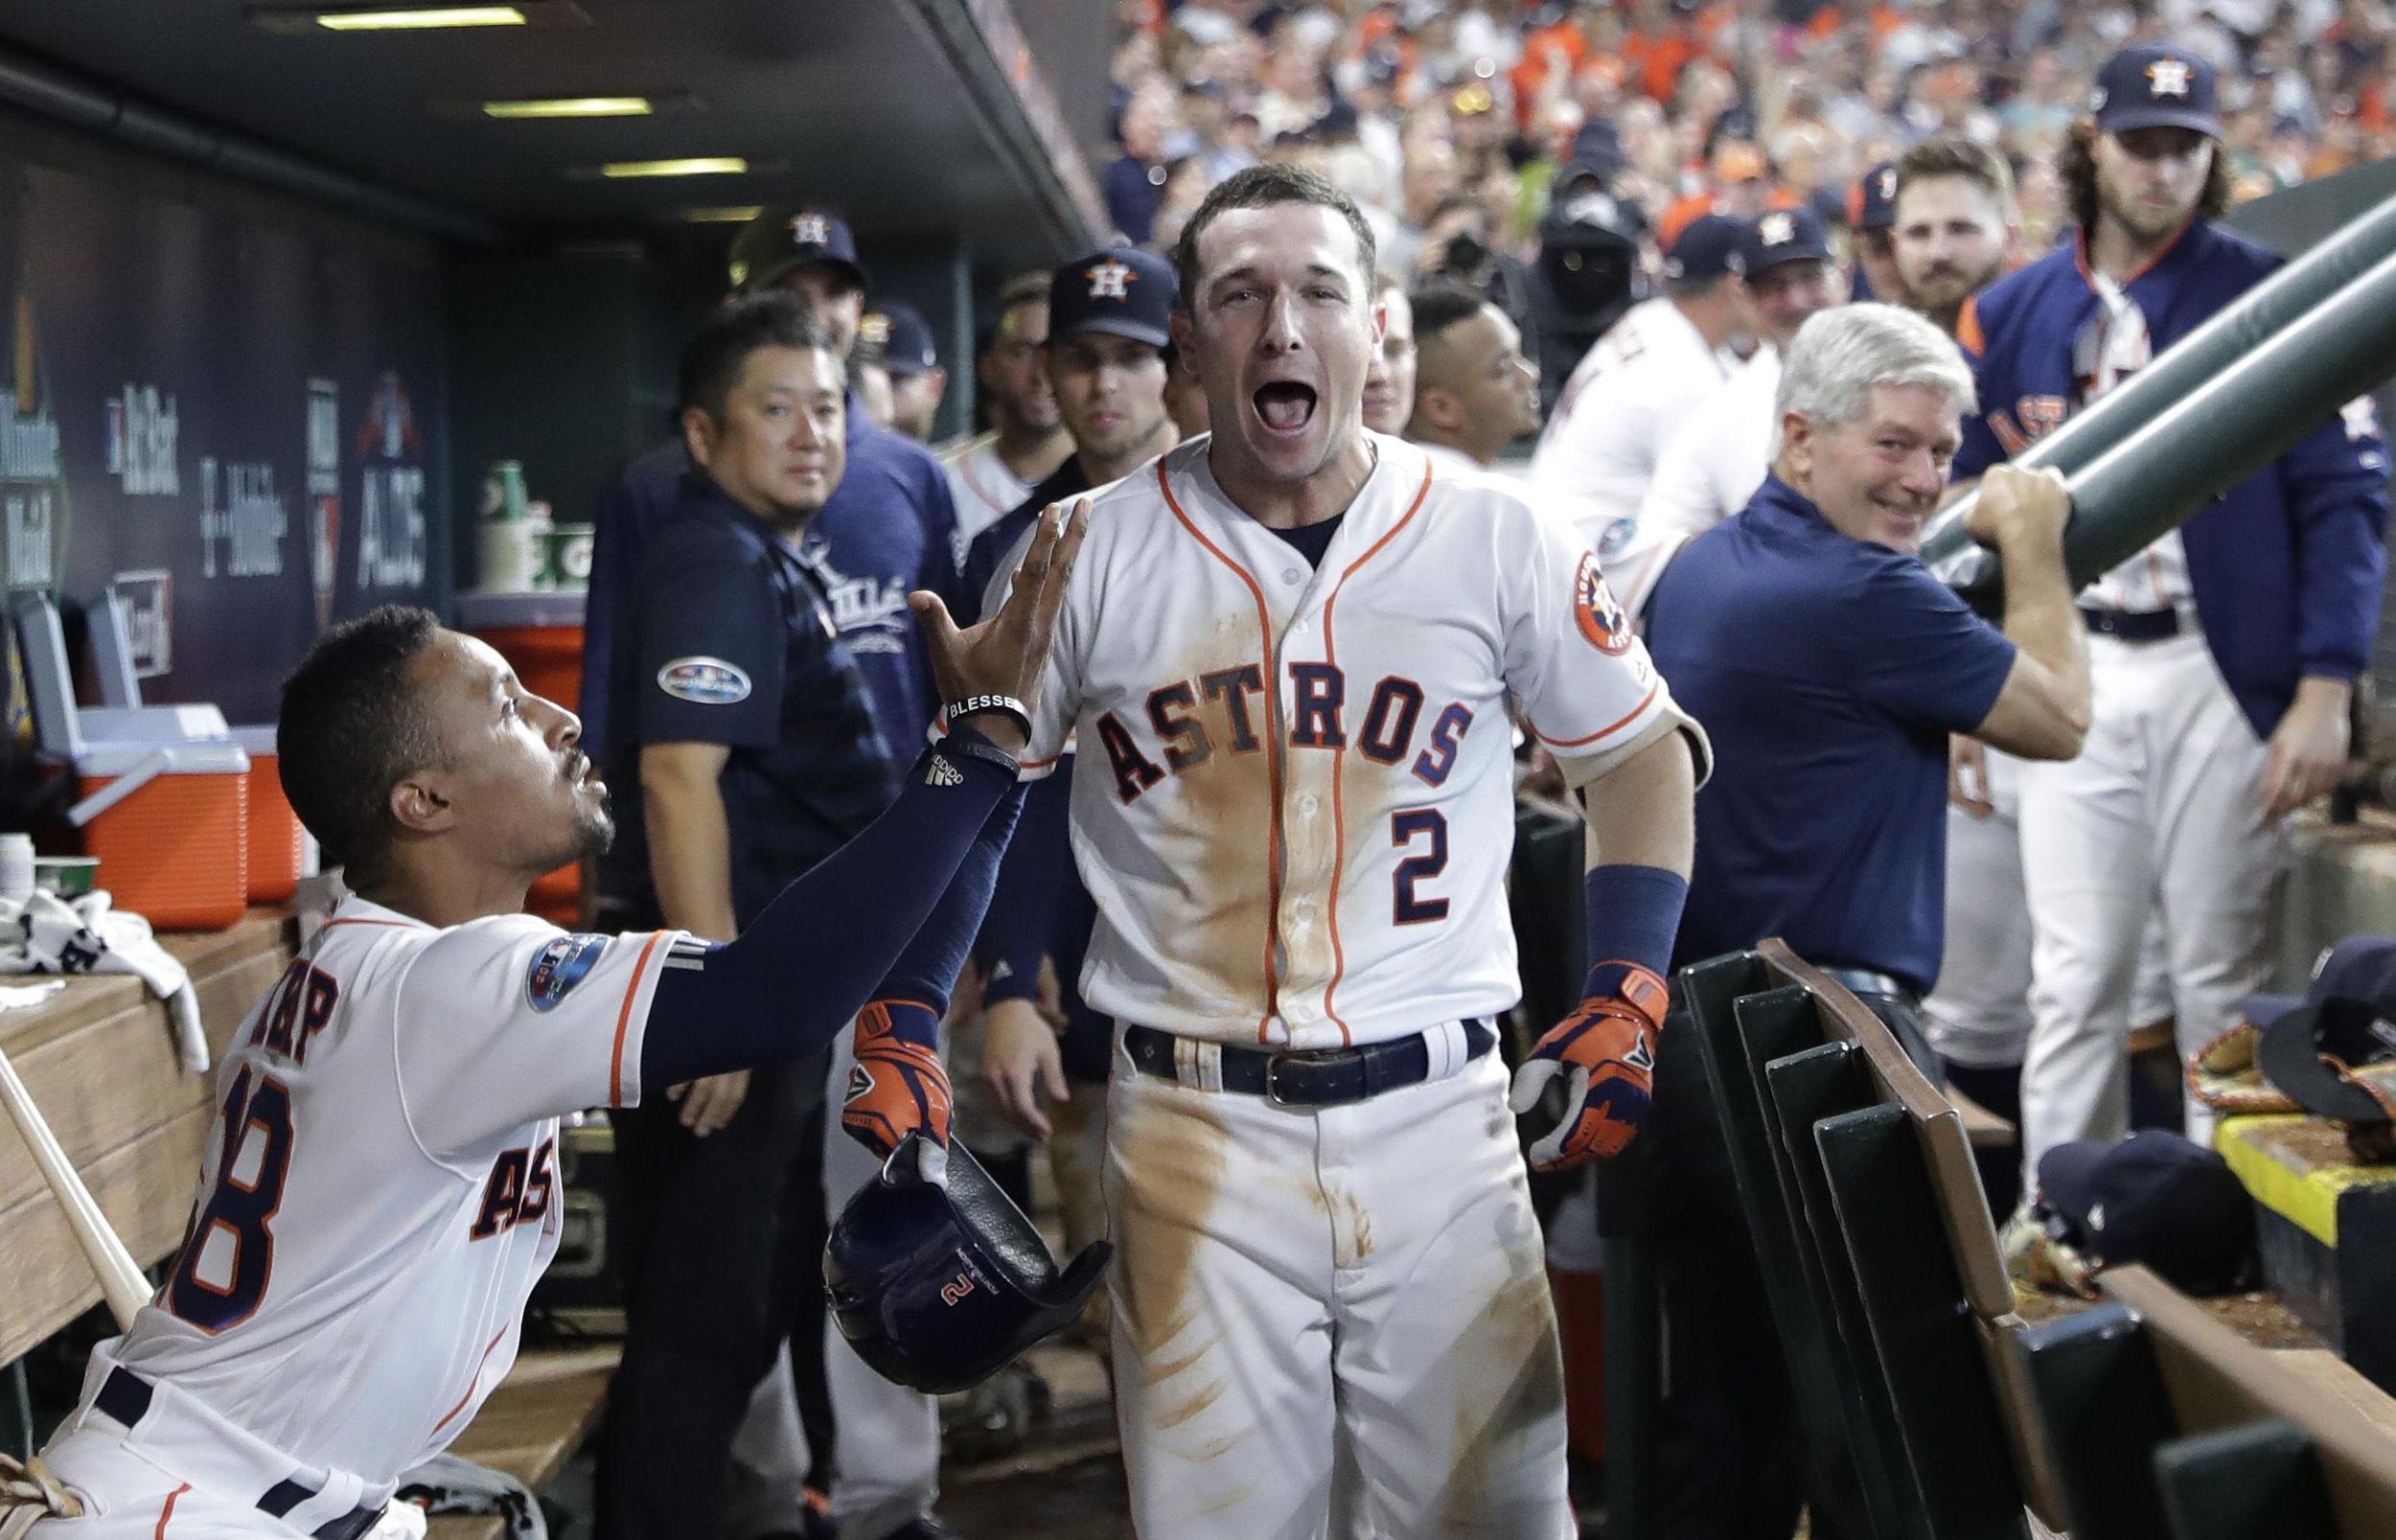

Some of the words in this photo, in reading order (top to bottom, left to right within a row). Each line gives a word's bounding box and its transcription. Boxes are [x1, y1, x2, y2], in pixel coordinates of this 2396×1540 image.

[1095, 661, 1475, 805] ASTROS
[1391, 807, 1451, 927] 2
[469, 1137, 555, 1243] AS
[940, 1272, 976, 1306] 2
